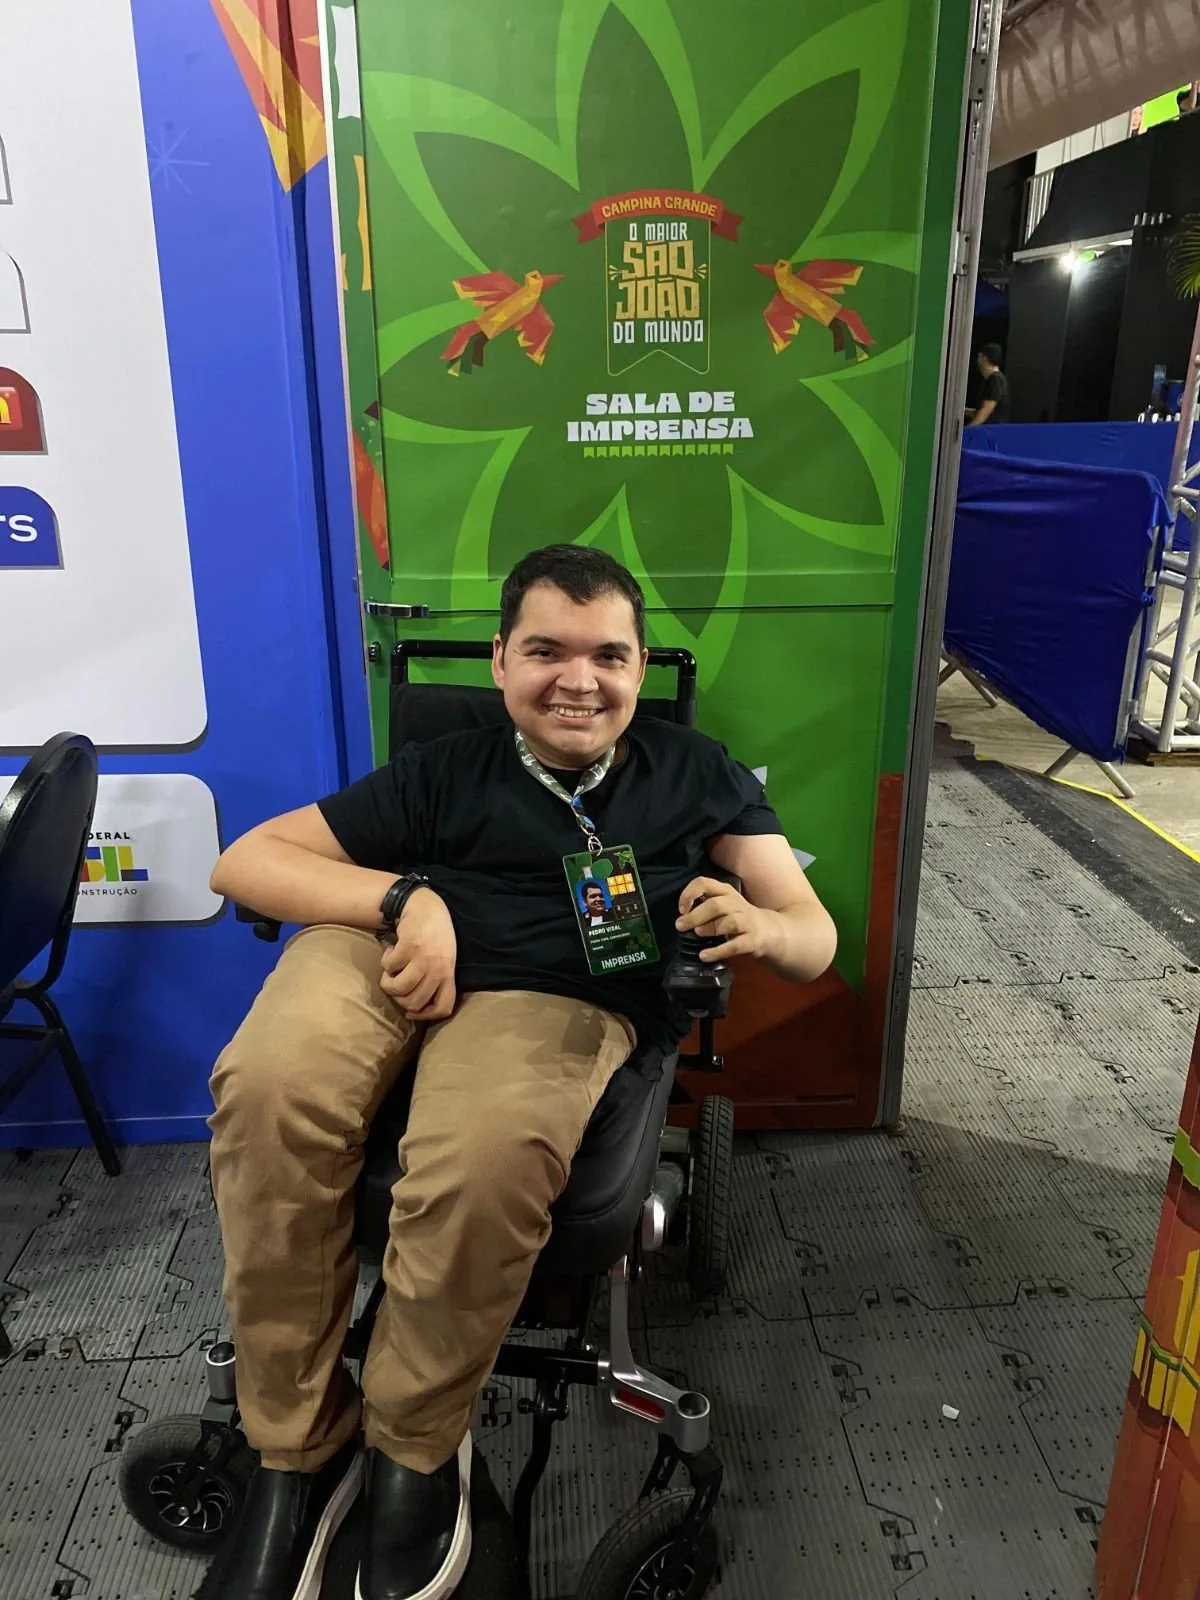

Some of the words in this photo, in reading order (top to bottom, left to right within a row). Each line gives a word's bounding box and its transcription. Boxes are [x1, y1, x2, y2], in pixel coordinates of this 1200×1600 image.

[602, 196, 661, 218] CAMPINA
[664, 196, 717, 217] GRANDE
[629, 223, 637, 241] O
[645, 222, 688, 241] MAIOR
[622, 240, 694, 279] SÃO
[616, 277, 700, 319] JOÃO
[613, 321, 635, 343] DO
[645, 320, 704, 343] MUNDO
[586, 393, 681, 415] SALA
[688, 391, 735, 412] DE
[567, 417, 754, 441] IMPRENSA
[0, 515, 38, 542] S
[79, 887, 138, 896] NSTRUÇÃO
[588, 928, 606, 936] PEDRO
[601, 951, 647, 970] IMPRENSA
